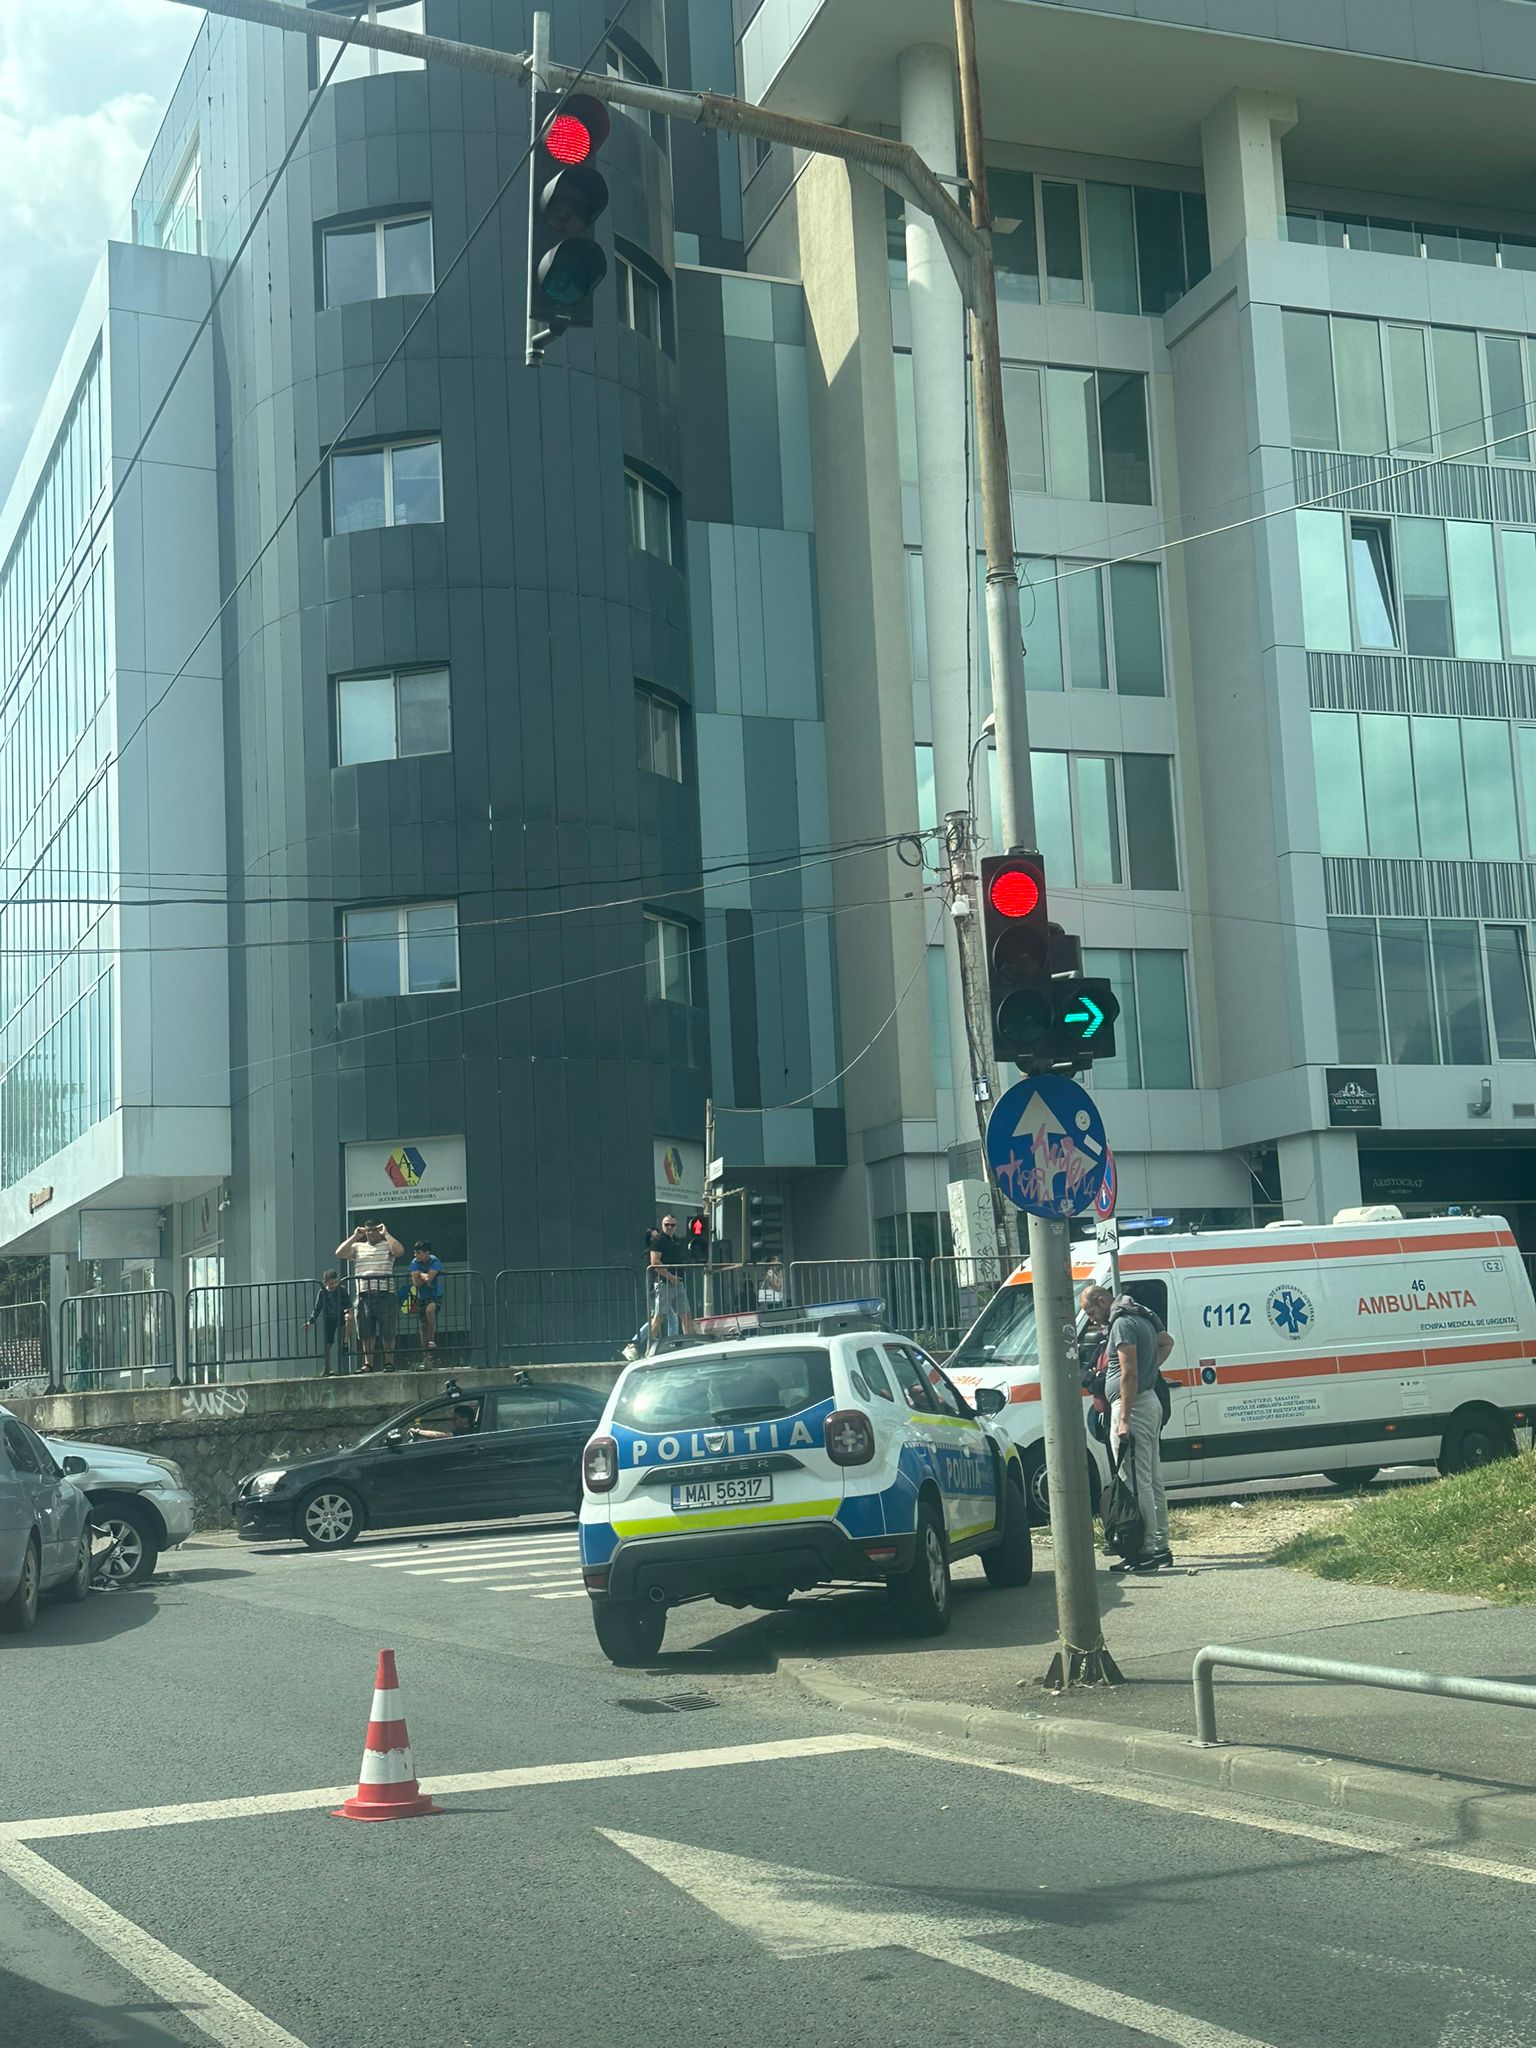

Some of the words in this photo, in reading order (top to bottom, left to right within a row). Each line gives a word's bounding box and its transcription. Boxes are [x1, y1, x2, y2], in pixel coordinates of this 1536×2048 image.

[1332, 1098, 1376, 1106] ARISTOCRAT
[1372, 1178, 1424, 1188] ARISTOCRAT
[1411, 1279, 1426, 1292] 46
[1357, 1289, 1477, 1316] AMBULANTA
[1447, 1319, 1475, 1329] MEDICAL
[1476, 1318, 1485, 1327] DE
[666, 1459, 770, 1479] DUSTER
[685, 1482, 711, 1504] MAI
[716, 1478, 762, 1500] 56317
